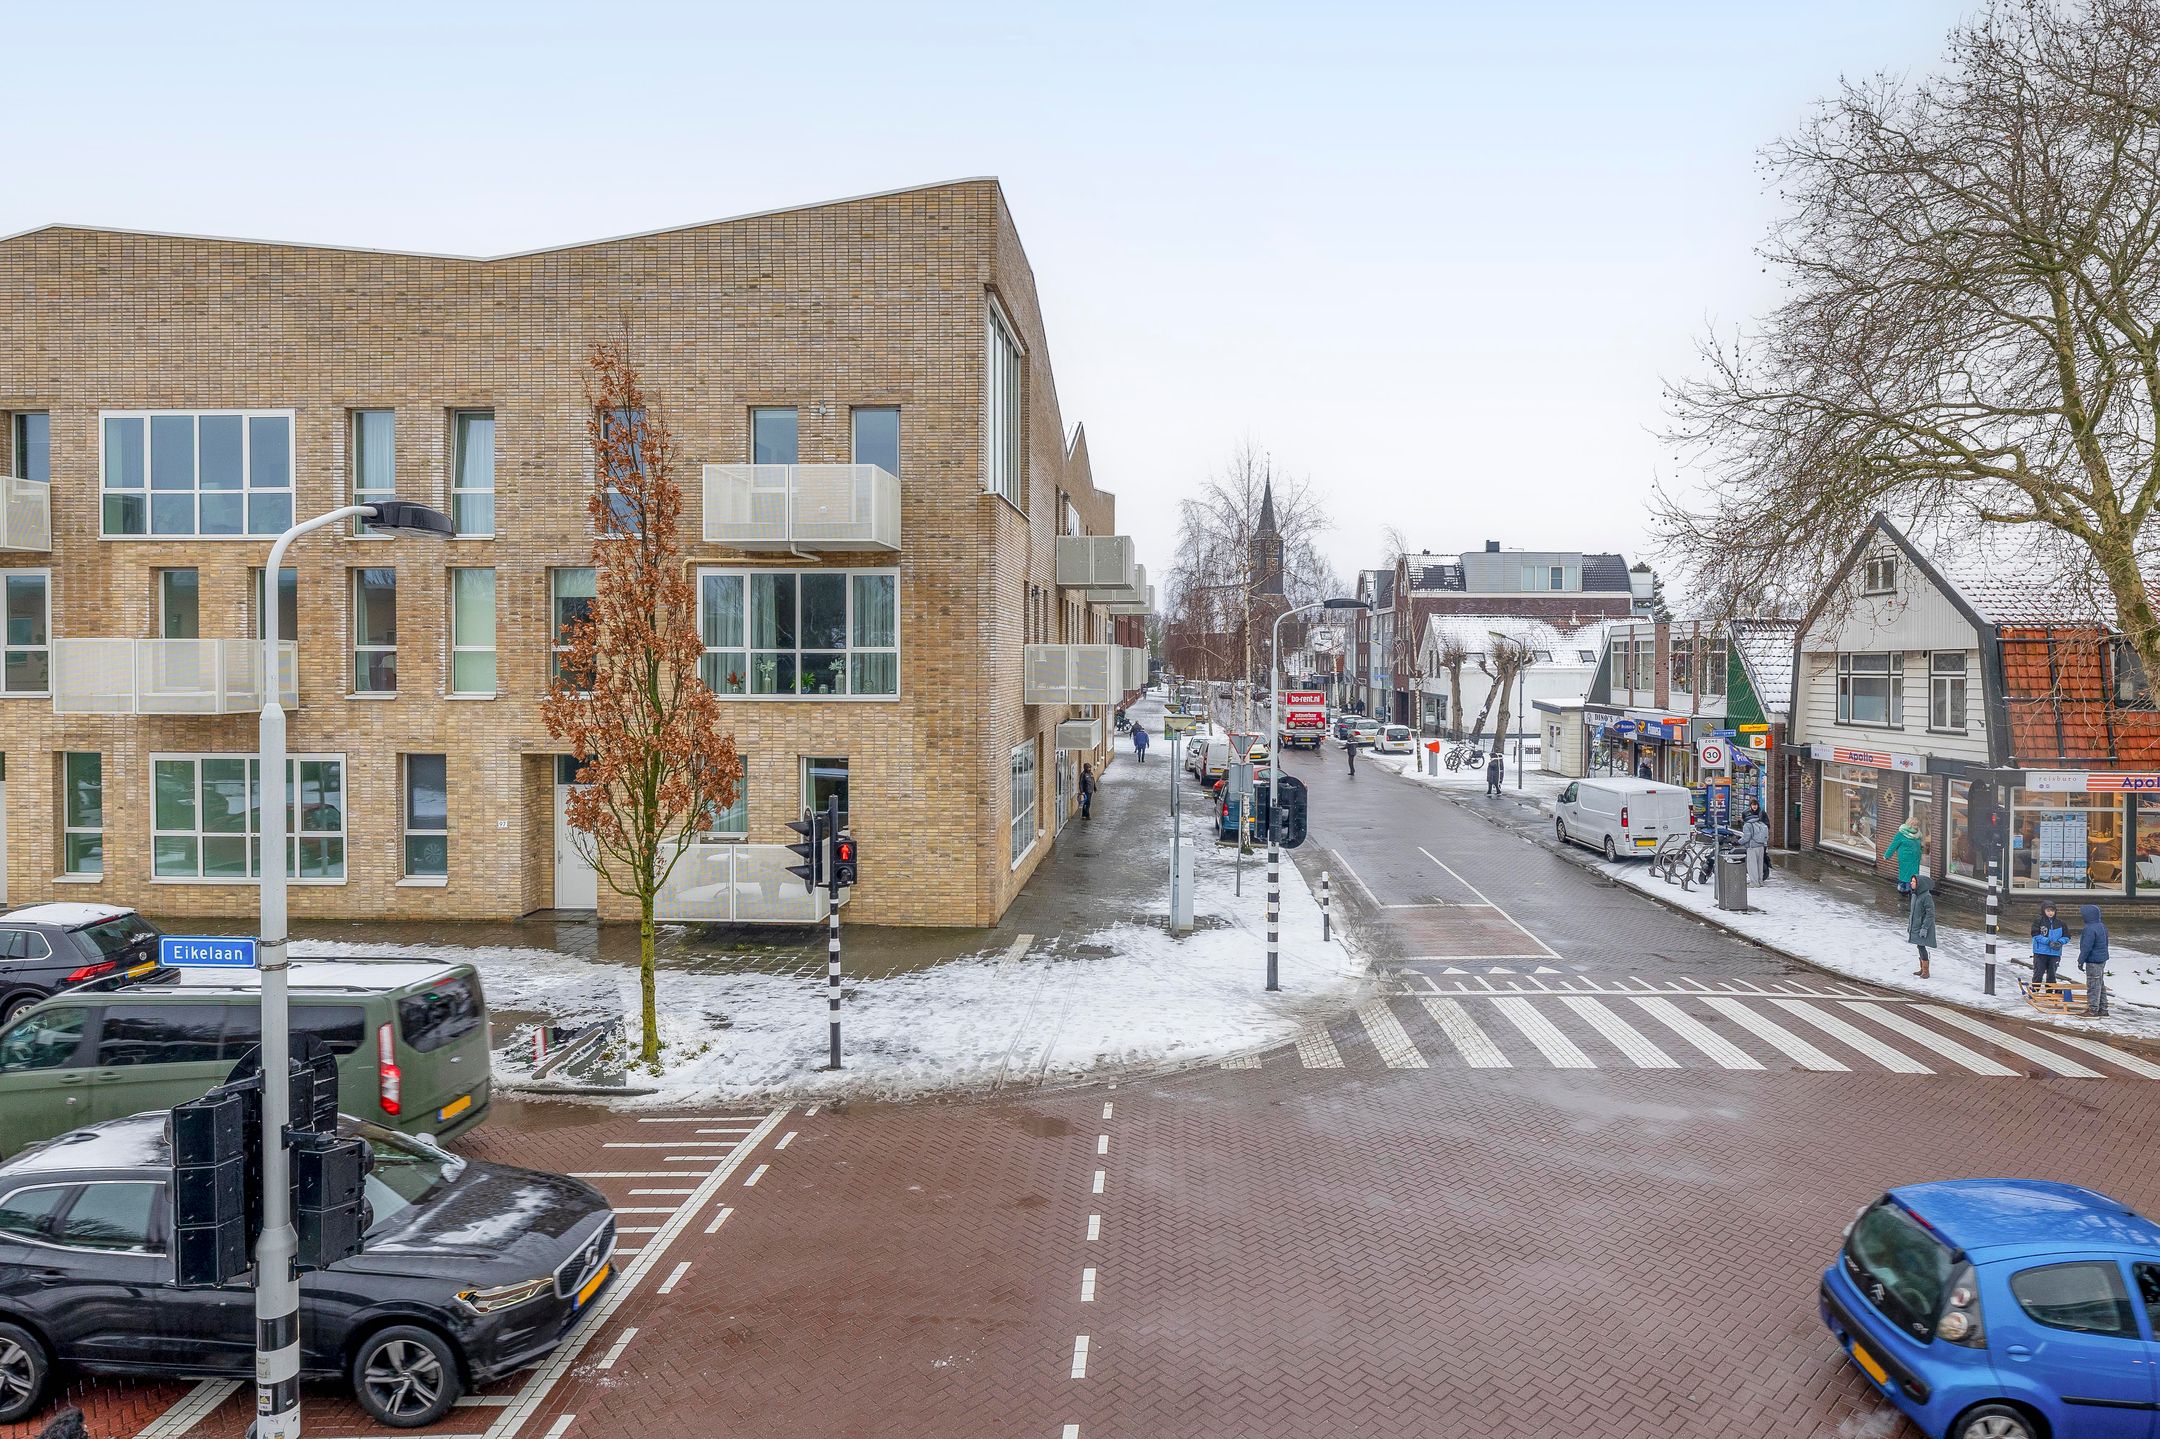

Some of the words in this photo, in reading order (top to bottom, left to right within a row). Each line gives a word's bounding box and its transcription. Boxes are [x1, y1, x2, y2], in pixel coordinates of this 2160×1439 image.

[1291, 695, 1320, 703] bo-rent.nl
[1594, 713, 1613, 722] DINO'S
[1706, 751, 1718, 759] 30
[1848, 751, 1874, 763] Apollo
[173, 945, 243, 961] Eikelaan
